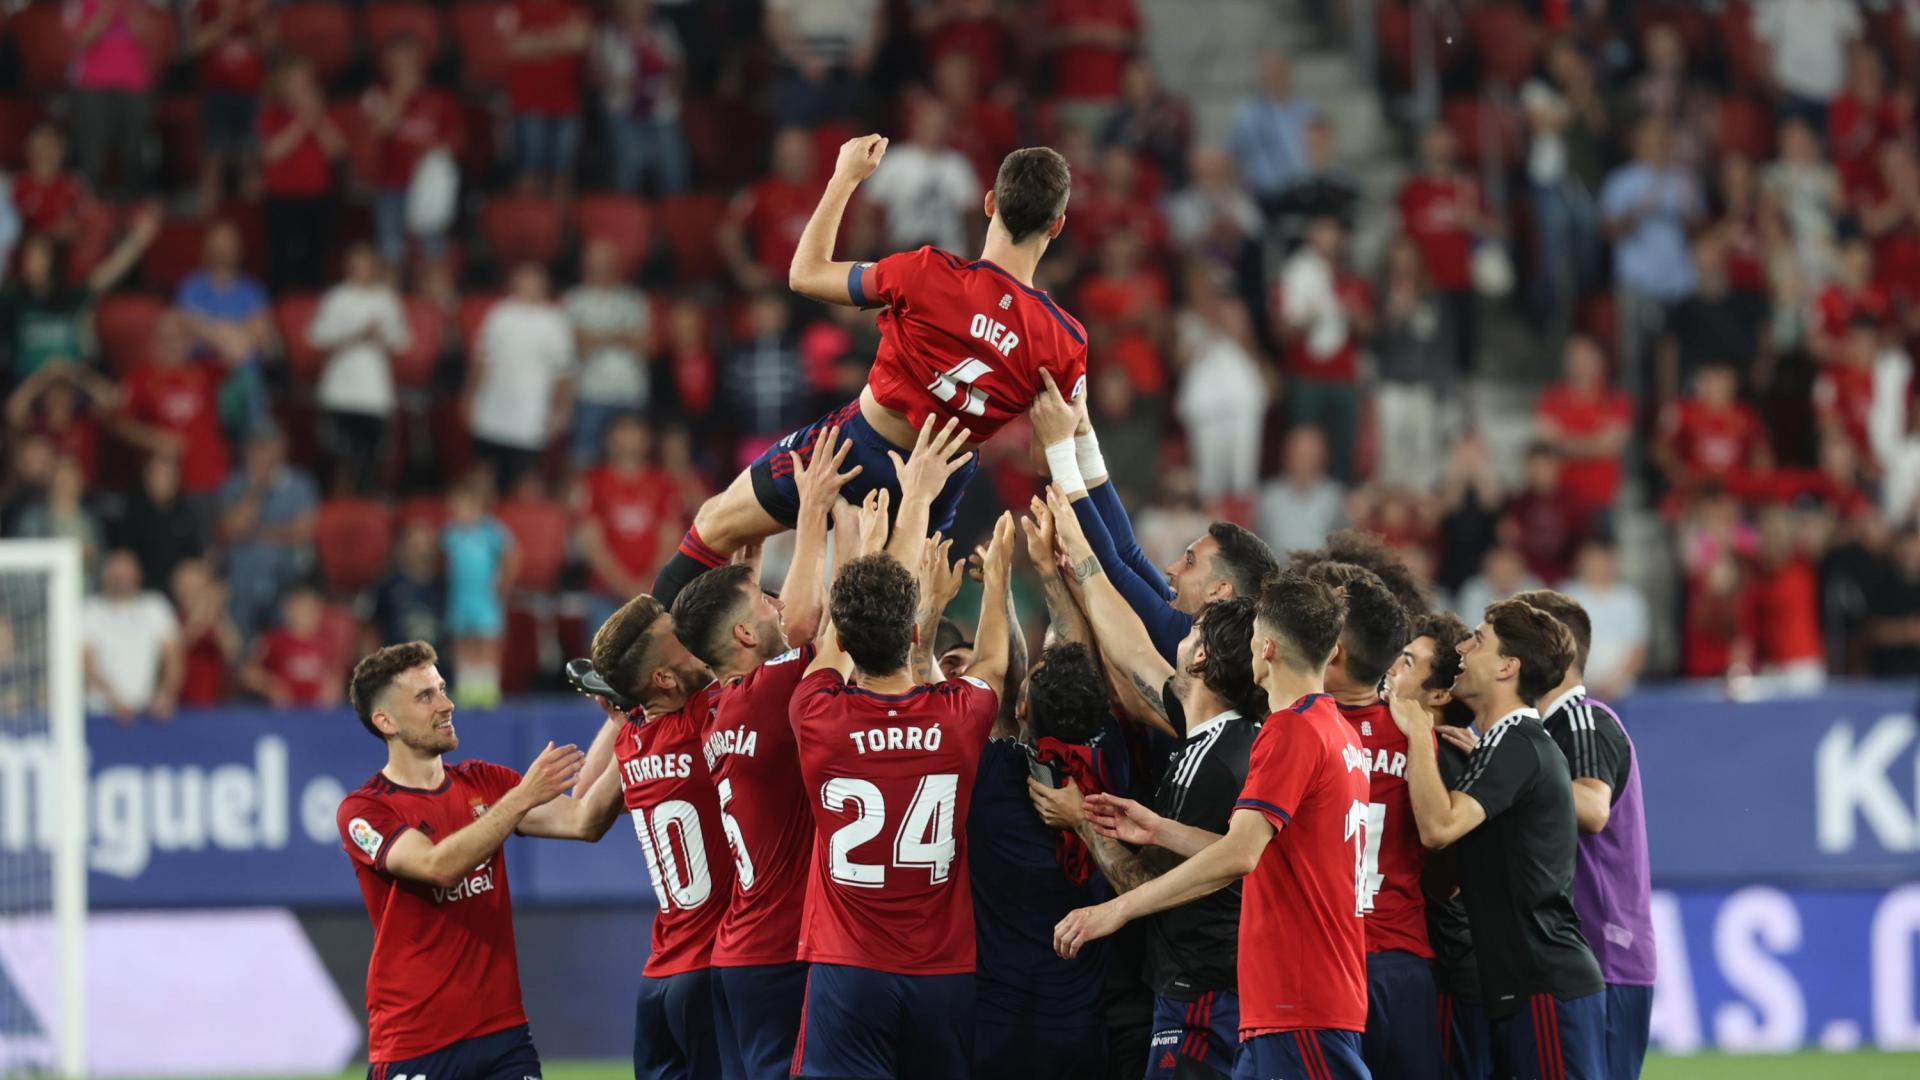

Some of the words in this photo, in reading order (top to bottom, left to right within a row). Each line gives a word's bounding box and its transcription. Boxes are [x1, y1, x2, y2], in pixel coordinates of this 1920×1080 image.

[970, 313, 1020, 357] OIER
[710, 724, 758, 758] GARCÍA
[850, 723, 942, 754] TORRÓ
[624, 753, 693, 785] TORRES
[820, 773, 960, 889] 24
[631, 799, 712, 914] 10
